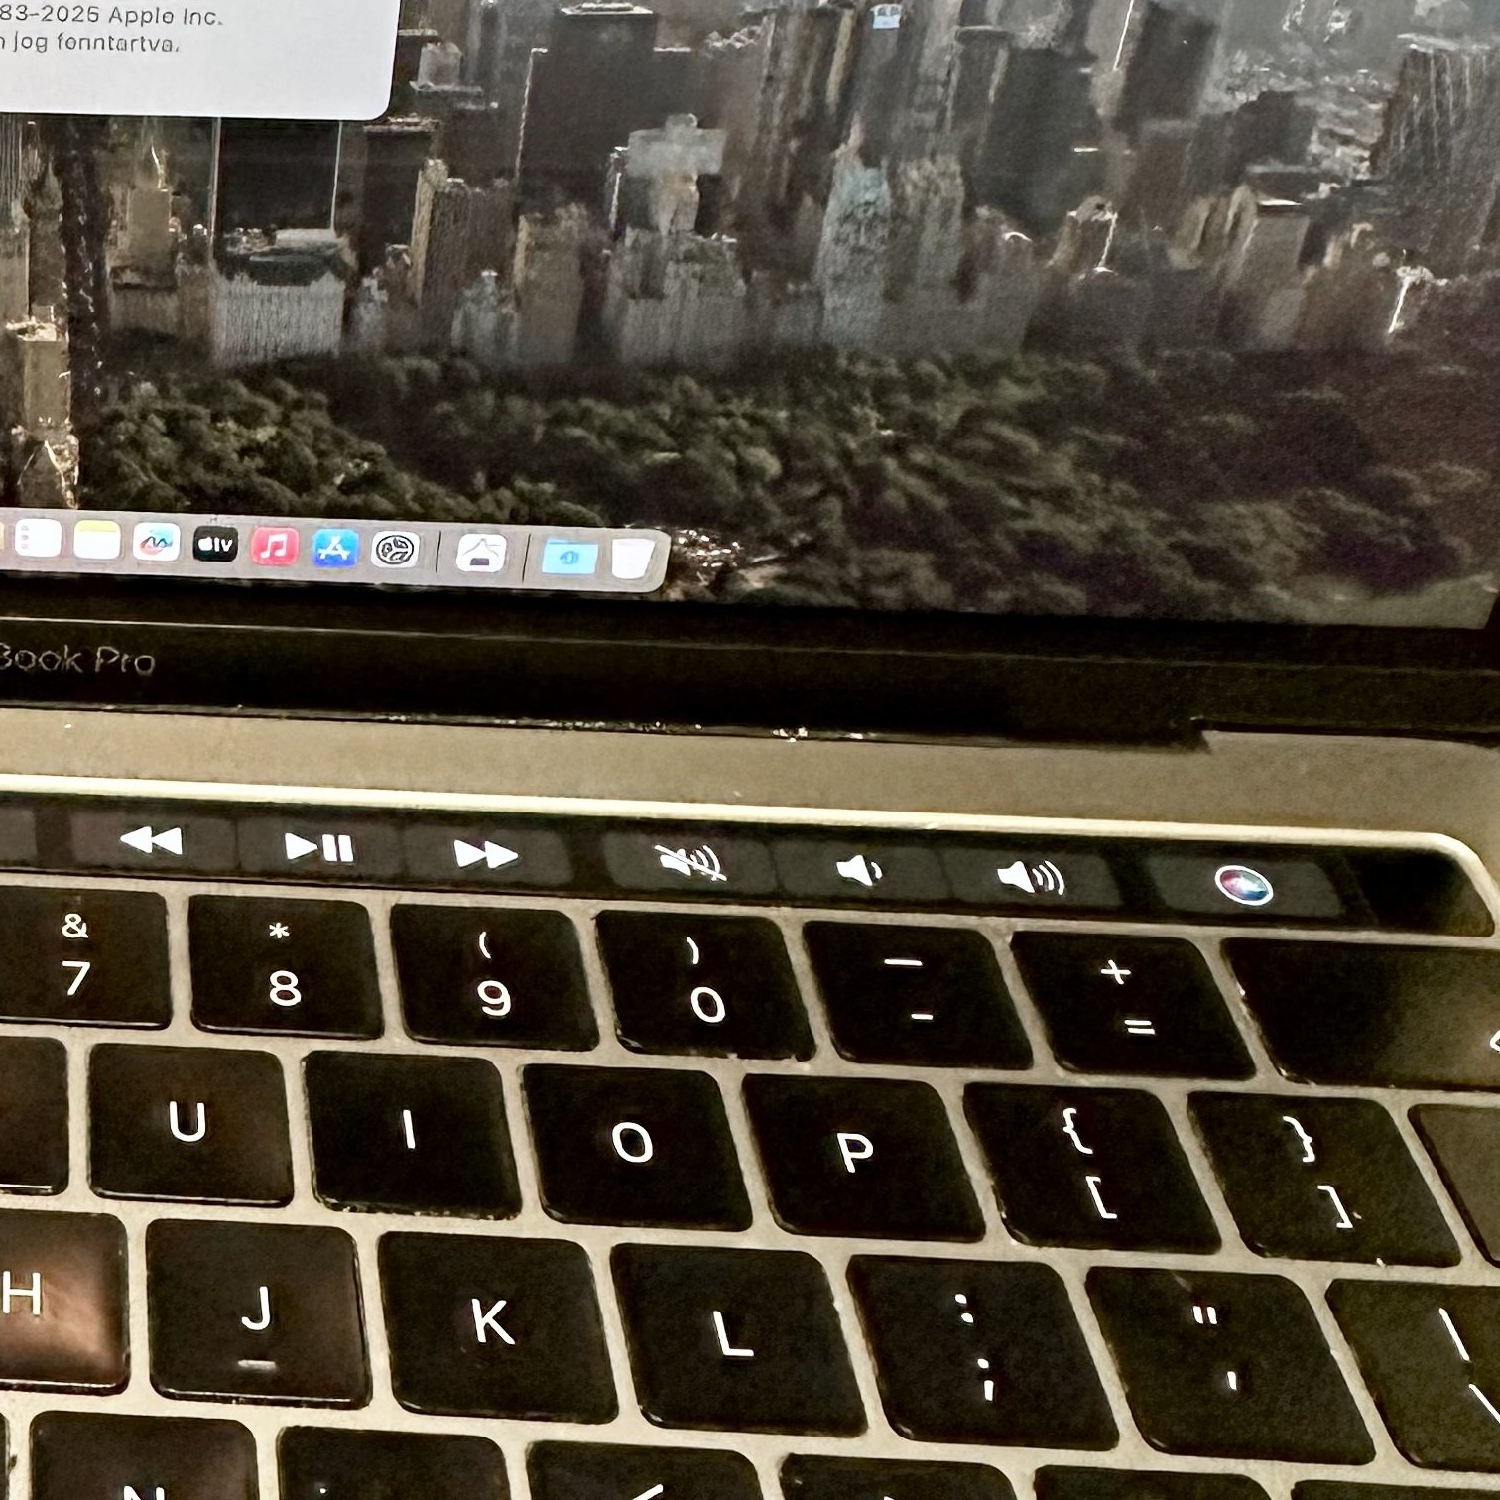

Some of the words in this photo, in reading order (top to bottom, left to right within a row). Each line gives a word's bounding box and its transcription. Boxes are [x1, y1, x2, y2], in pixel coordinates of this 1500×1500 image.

[184, 8, 222, 25] Inc.
[13, 31, 47, 53] jog
[94, 645, 157, 677] Pro
[61, 913, 89, 938] &
[61, 960, 91, 996] 7
[269, 970, 302, 1007] 8
[477, 980, 512, 1017] 9
[169, 1100, 206, 1143] U
[611, 1121, 654, 1163] O
[836, 1132, 874, 1174] P
[1, 1269, 44, 1316] H
[241, 1286, 271, 1331] J
[471, 1298, 516, 1345] K
[712, 1311, 755, 1357] L
